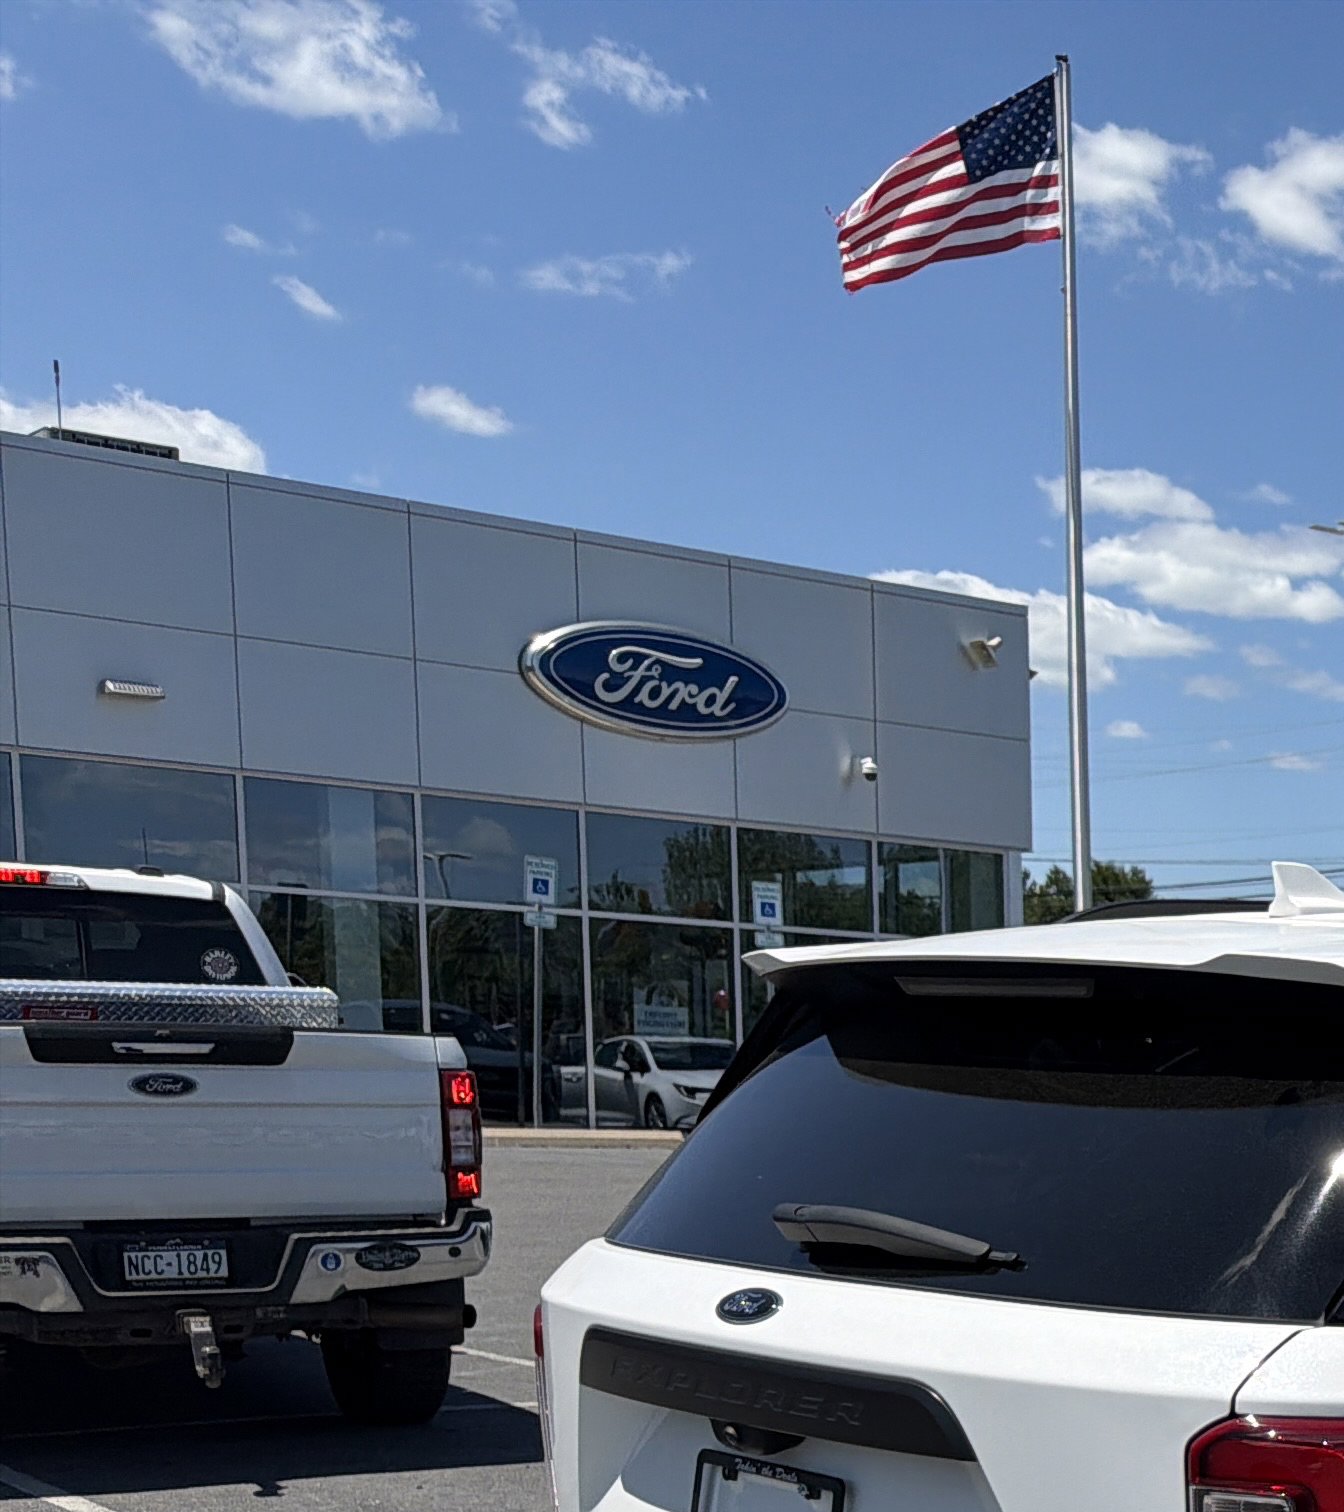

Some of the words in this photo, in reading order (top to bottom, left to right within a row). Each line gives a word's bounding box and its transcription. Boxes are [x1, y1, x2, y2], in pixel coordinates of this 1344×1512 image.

[594, 646, 739, 717] Ford
[145, 1078, 183, 1092] Ford
[127, 1251, 223, 1277] NCC-1849
[724, 1292, 767, 1314] Ford
[610, 1358, 865, 1427] EXPLORER
